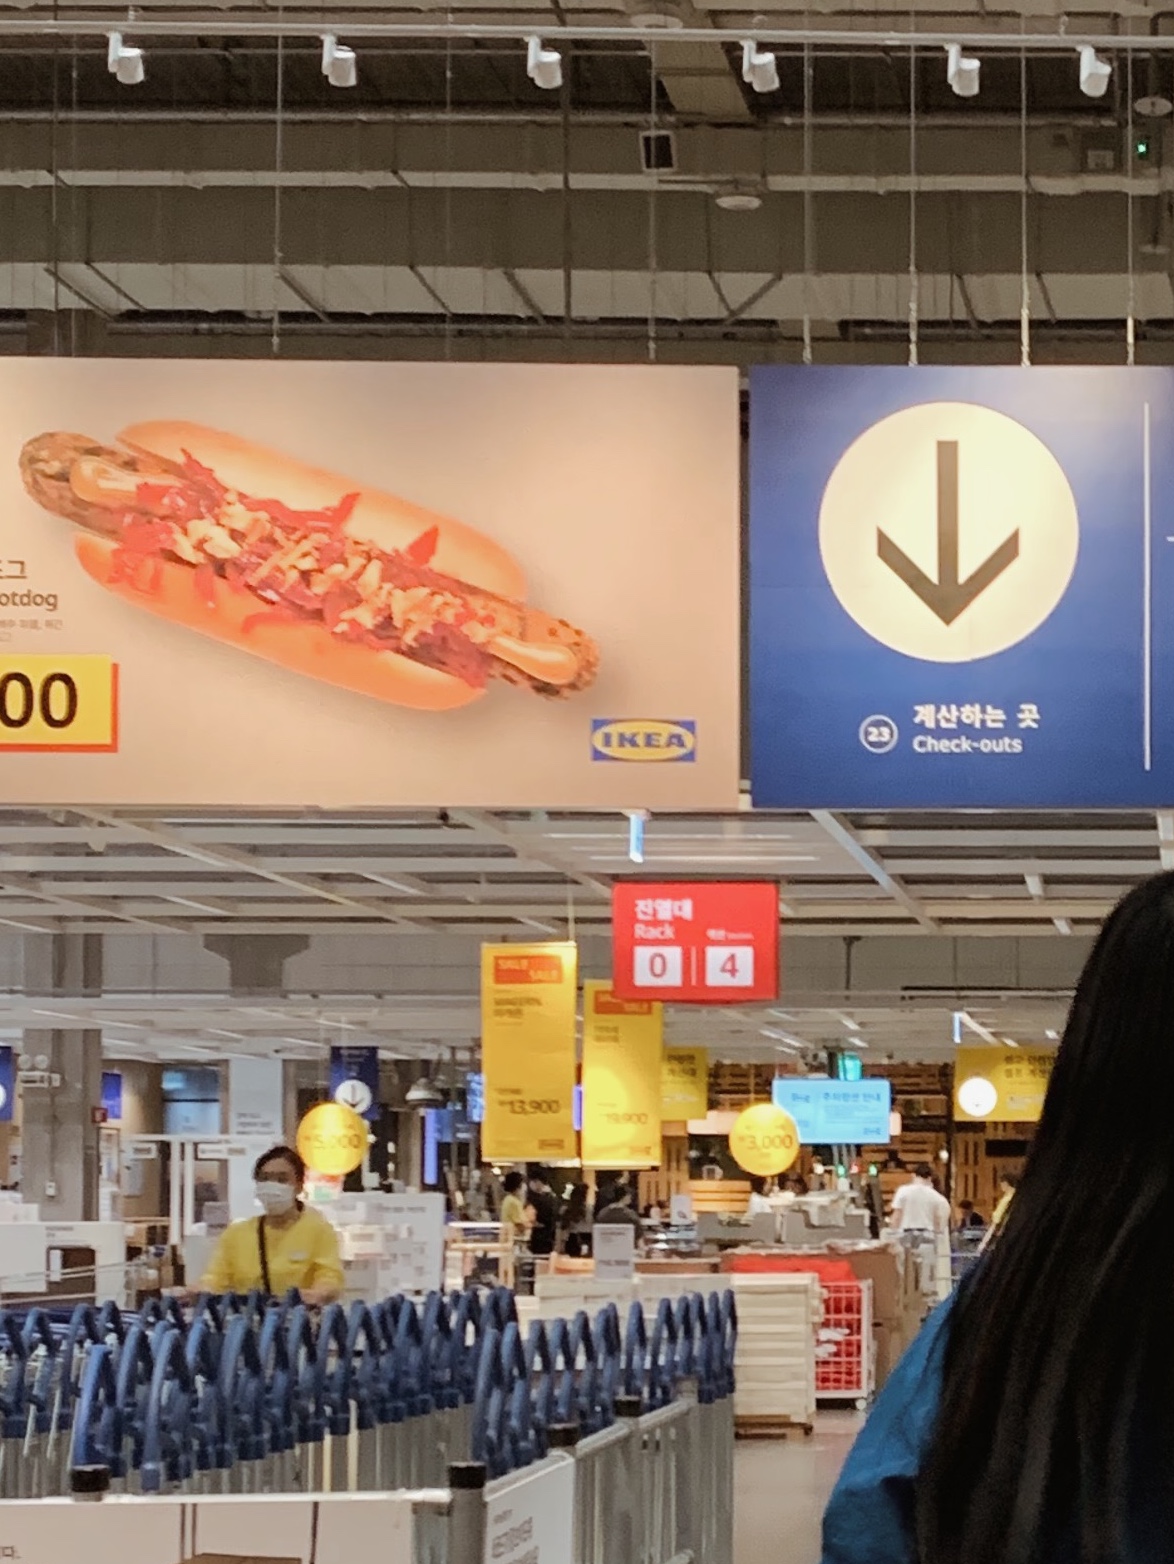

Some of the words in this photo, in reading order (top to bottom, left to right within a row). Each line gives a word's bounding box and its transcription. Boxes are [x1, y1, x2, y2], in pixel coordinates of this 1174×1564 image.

[0, 672, 78, 728] 00
[912, 703, 1007, 729] 계산하는
[1016, 703, 1041, 729] 곳
[601, 731, 687, 749] IKEA
[866, 726, 891, 742] 23
[912, 735, 1024, 753] Check-outs
[635, 898, 693, 921] 진열대
[634, 923, 675, 940] Rack
[649, 952, 667, 978] 0
[720, 952, 739, 979] 4
